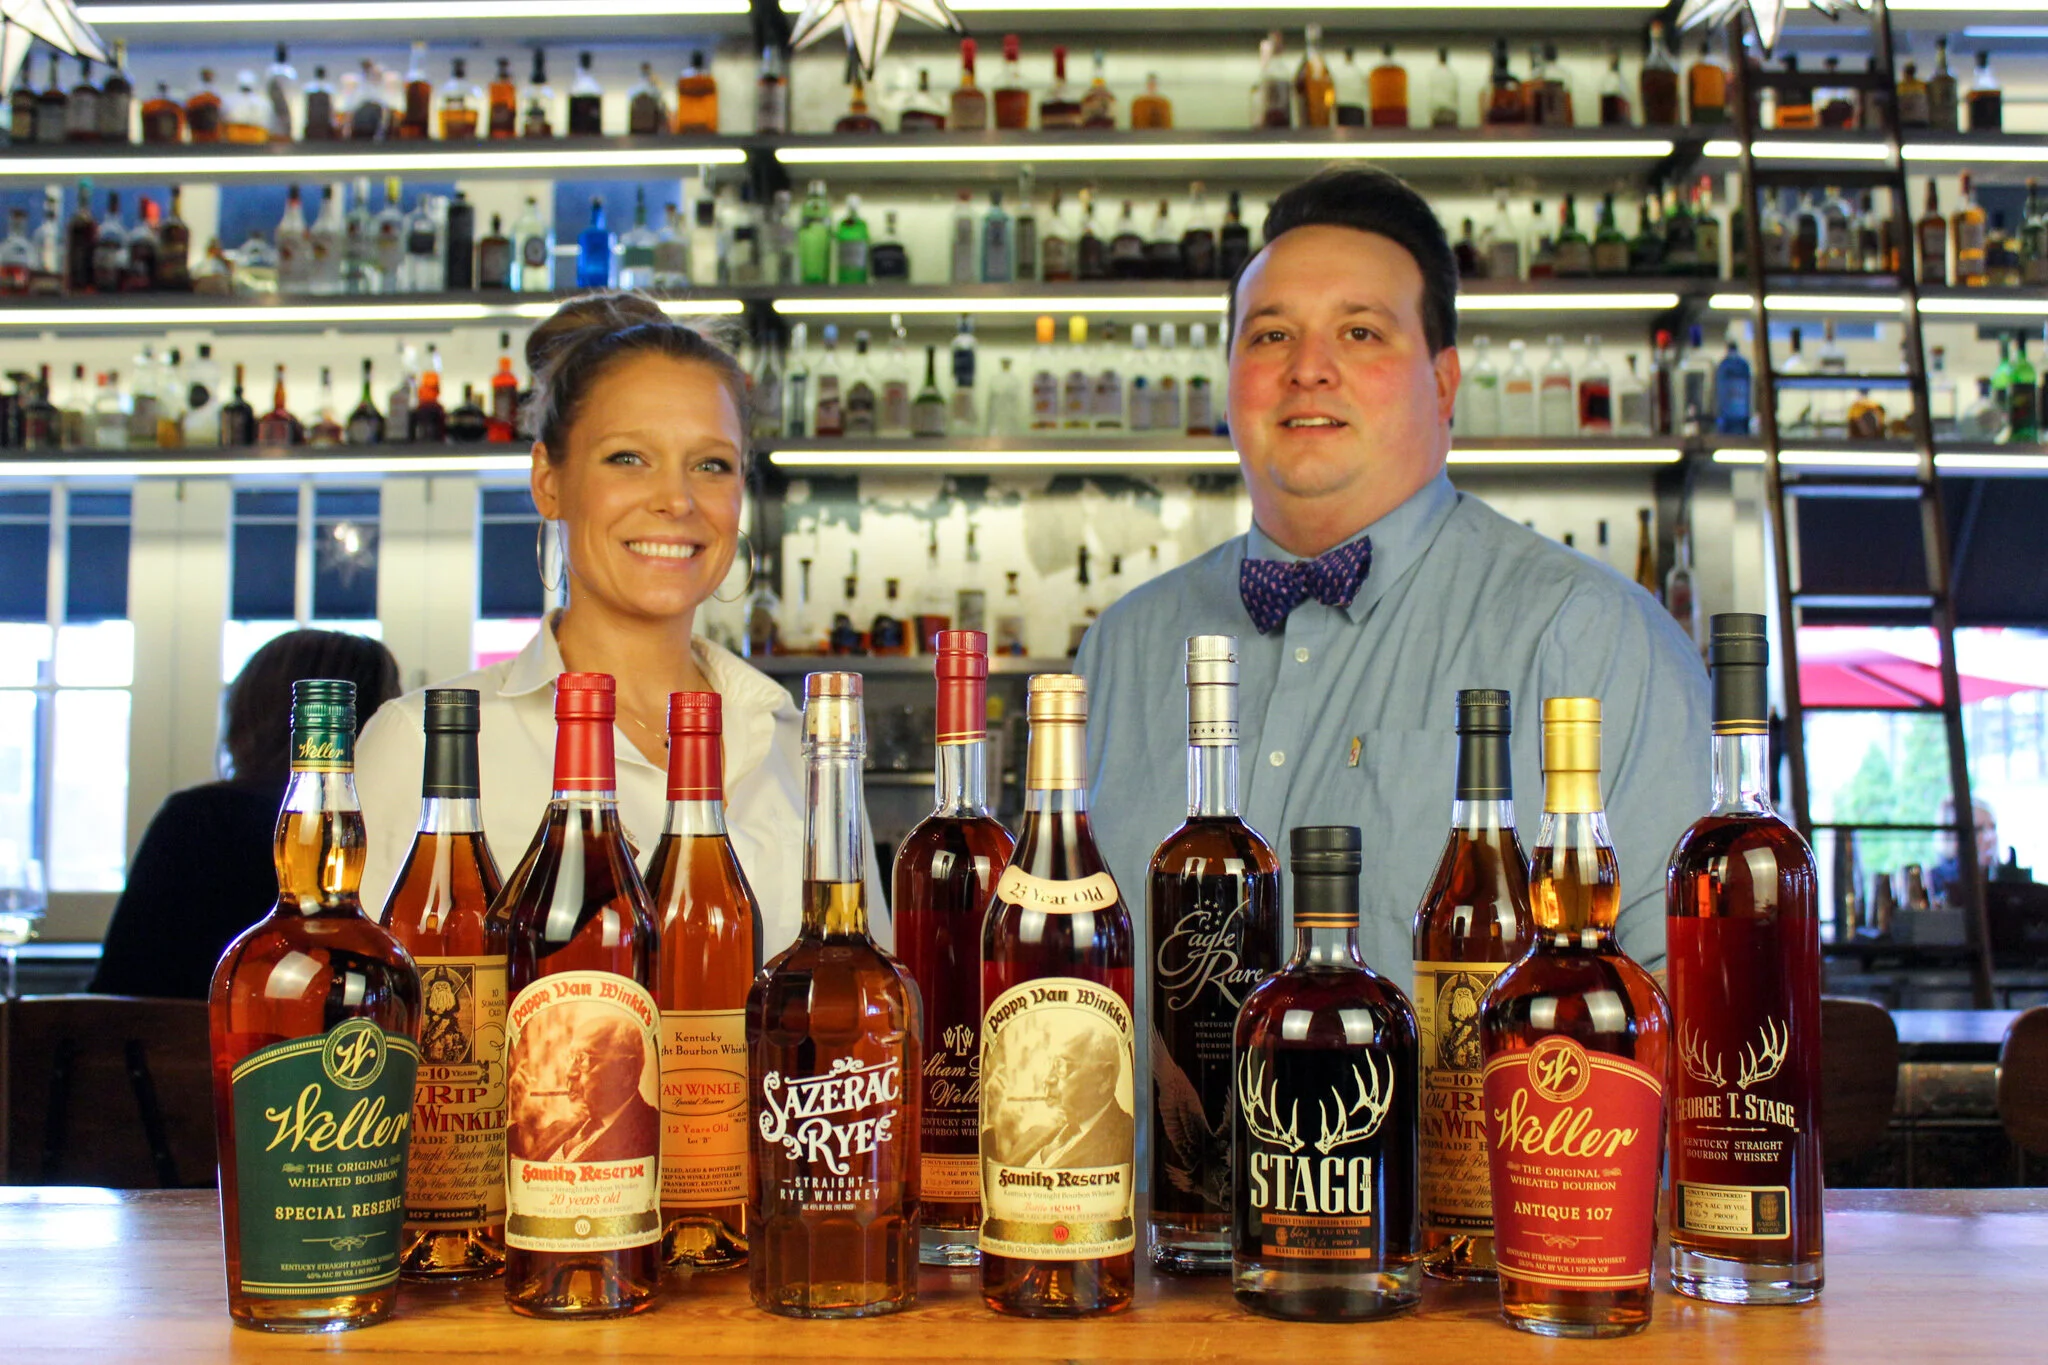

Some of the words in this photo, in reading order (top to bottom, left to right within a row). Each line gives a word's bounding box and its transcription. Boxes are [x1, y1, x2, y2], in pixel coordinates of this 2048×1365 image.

[298, 737, 344, 759] Weller
[1073, 885, 1105, 903] Old
[1157, 899, 1251, 989] Eagle
[1167, 949, 1264, 1011] Rare
[552, 981, 593, 998] Van
[1029, 987, 1070, 1005] Van
[1075, 988, 1128, 1034] Winkle's
[675, 1032, 722, 1042] Kentucky
[676, 1045, 718, 1055] Bourbon
[720, 1043, 747, 1054] Whisk
[429, 1067, 450, 1080] 10
[922, 1052, 966, 1077] illiam
[661, 1083, 683, 1096] AN
[685, 1082, 741, 1095] WINKLE
[1453, 1074, 1473, 1087] 10
[427, 1085, 488, 1104] RIP
[1425, 1092, 1448, 1109] Old
[1451, 1091, 1485, 1111] RI
[759, 1066, 900, 1142] SAZERAC
[1675, 1096, 1722, 1123] GEORGE
[1727, 1092, 1741, 1119] T.
[1744, 1093, 1794, 1128] STAGG
[265, 1082, 410, 1152] Weller
[416, 1103, 506, 1133] WINKLE
[921, 1118, 959, 1126] ENTUCKY
[1423, 1117, 1442, 1139] AN
[1442, 1110, 1488, 1139] WIN
[1494, 1087, 1639, 1158] Weller
[455, 1131, 506, 1144] BOURBO
[667, 1125, 679, 1134] 12
[683, 1124, 711, 1134] Years
[712, 1123, 729, 1133] Old
[797, 1117, 880, 1175] RYE
[1683, 1136, 1729, 1149] KENTUCKY
[1734, 1140, 1784, 1151] STRAIGHT
[1686, 1149, 1728, 1161] BOURBON
[1734, 1152, 1780, 1162] WHISKEY
[307, 1163, 333, 1174] THE
[337, 1158, 388, 1173] ORIGINAL
[521, 1163, 577, 1185] Family
[578, 1163, 644, 1183] Reserve
[1522, 1164, 1541, 1175] THE
[1545, 1167, 1600, 1178] ORIGINAL
[288, 1177, 351, 1188] WHEATED
[355, 1170, 398, 1185] BOURBON
[795, 1176, 864, 1188] STRAIGHT
[998, 1168, 1055, 1190] Family
[1056, 1171, 1120, 1188] Reserve
[1250, 1152, 1371, 1214] STAGG
[1510, 1175, 1559, 1189] WHEATED
[1562, 1181, 1617, 1191] BOURBON
[549, 1193, 565, 1206] 20
[568, 1194, 600, 1209] years
[603, 1191, 621, 1204] old
[780, 1188, 804, 1201] RYE
[814, 1188, 880, 1201] WHISKEY
[275, 1205, 346, 1220] SPECIAL
[352, 1195, 401, 1218] RESERVE
[1513, 1201, 1580, 1222] ANTIQUE
[1586, 1207, 1613, 1221] 107
[1460, 1218, 1494, 1226] PROO
[1506, 1246, 1531, 1259] KENTUCKY
[1531, 1253, 1563, 1263] STRAIGHT
[1563, 1256, 1597, 1264] BOURBON
[1597, 1255, 1627, 1265] WHISKEY
[280, 1263, 316, 1271] KENTUCKY
[317, 1261, 350, 1270] STRAIGHT
[1535, 1262, 1547, 1270] ALC
[1587, 1265, 1609, 1273] PROOF
